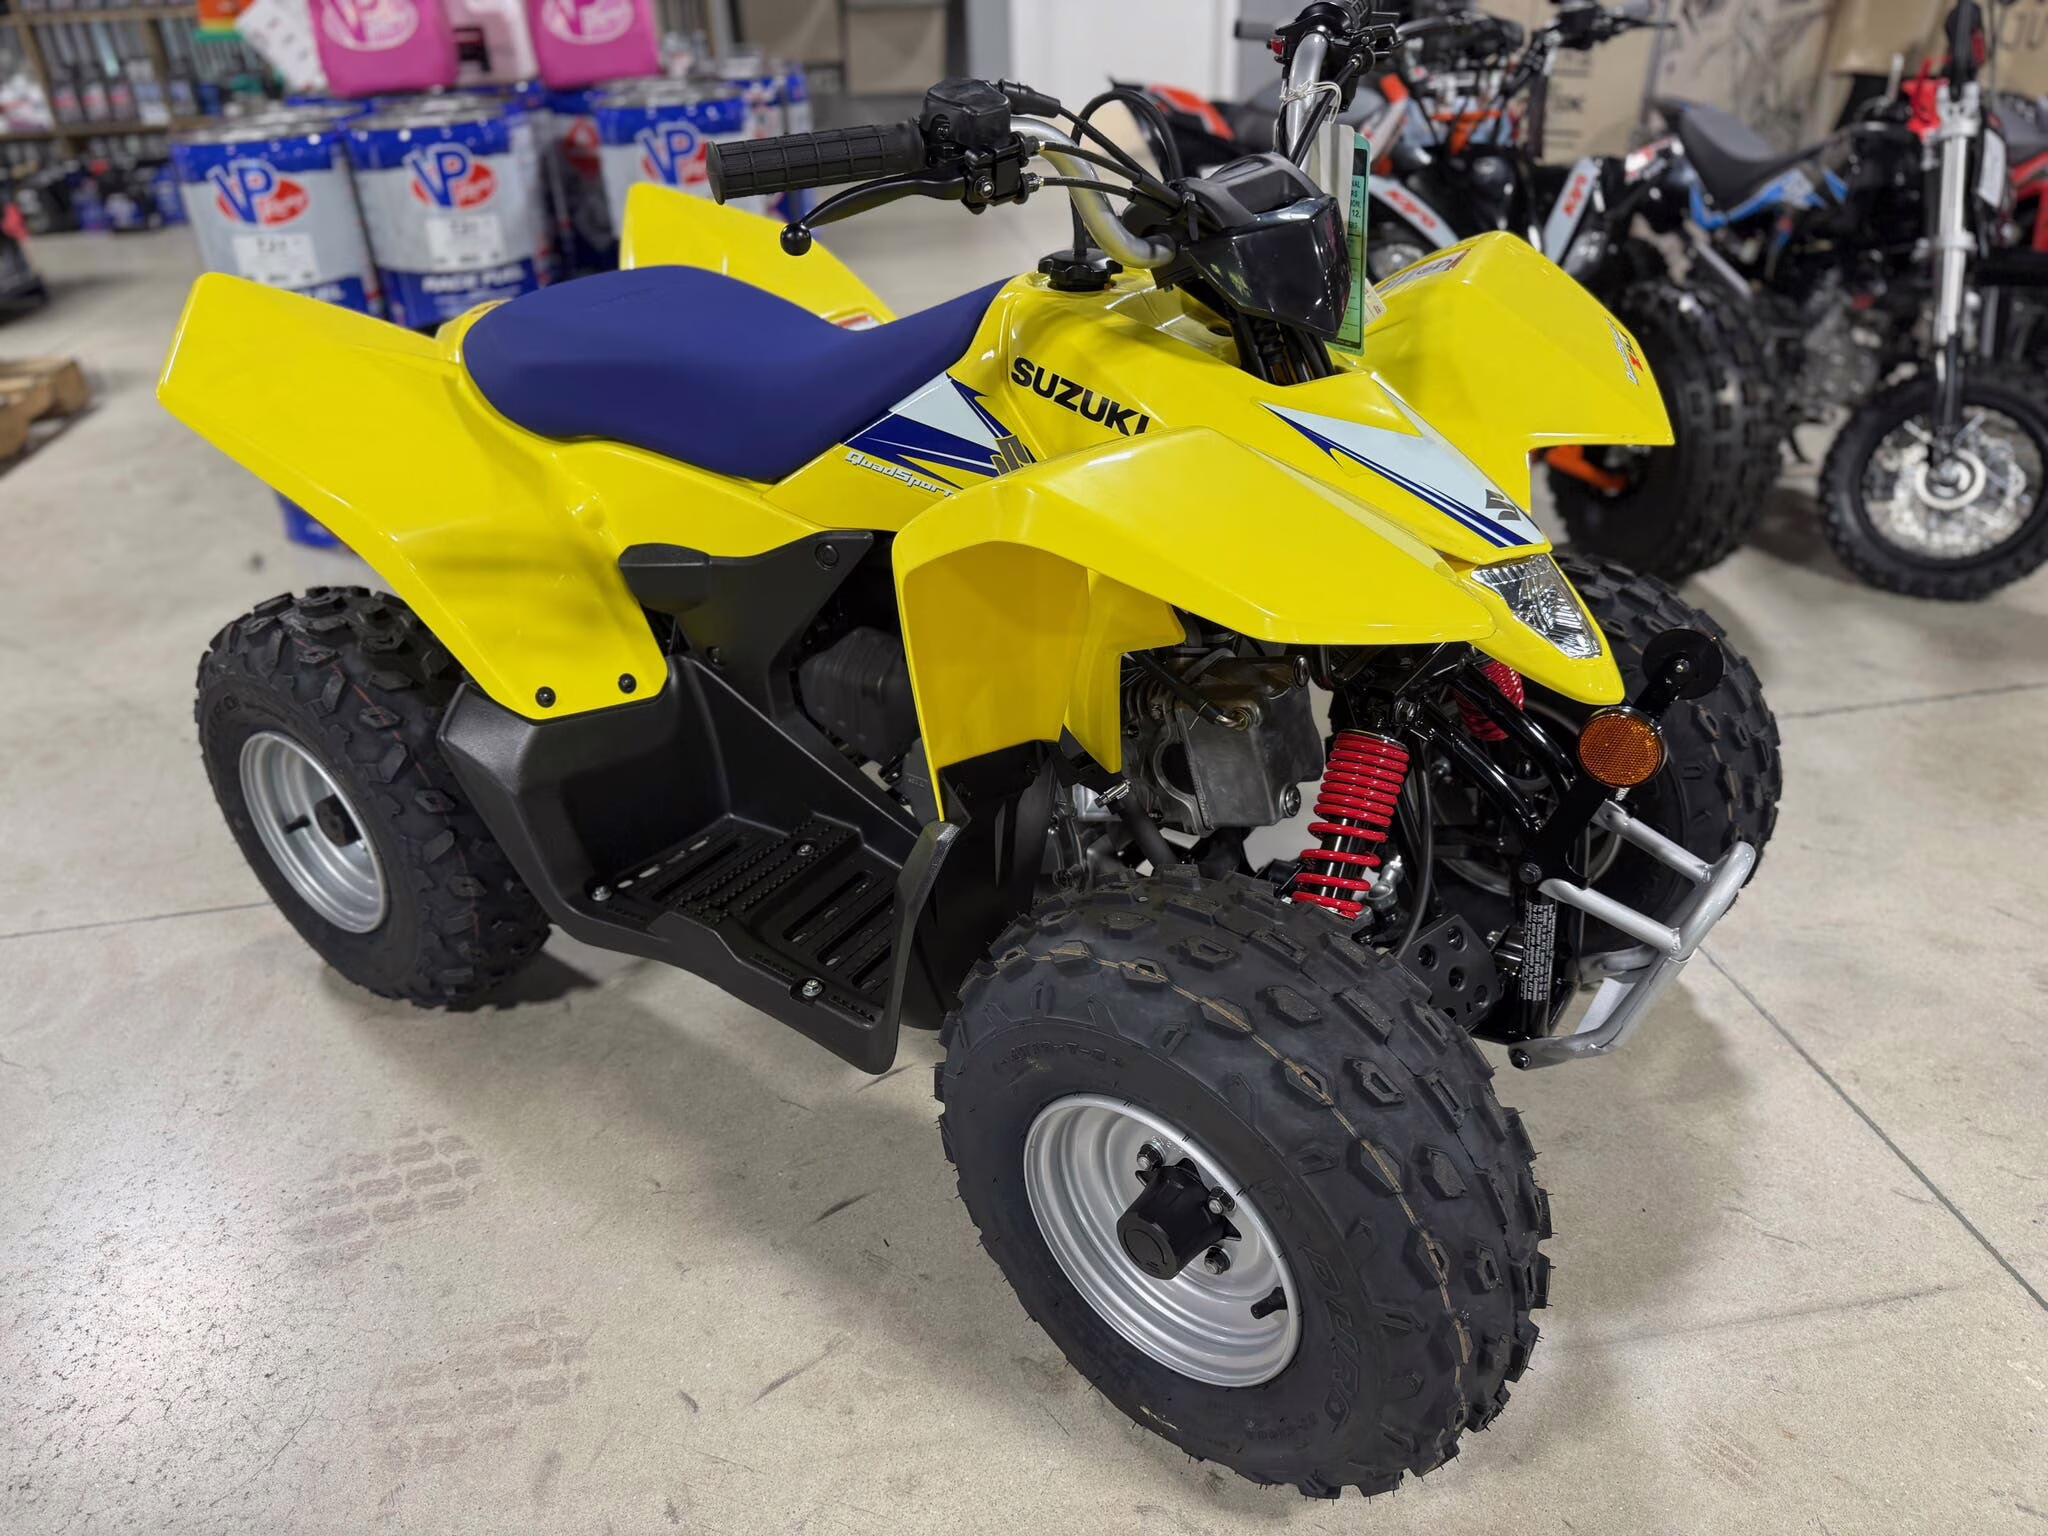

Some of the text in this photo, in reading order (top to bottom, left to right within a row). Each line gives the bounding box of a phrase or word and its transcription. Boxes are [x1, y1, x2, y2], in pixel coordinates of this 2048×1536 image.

[407, 146, 471, 207] VP
[640, 125, 698, 185] VP
[209, 162, 276, 225] VP
[1011, 357, 1150, 437] SUZUKI
